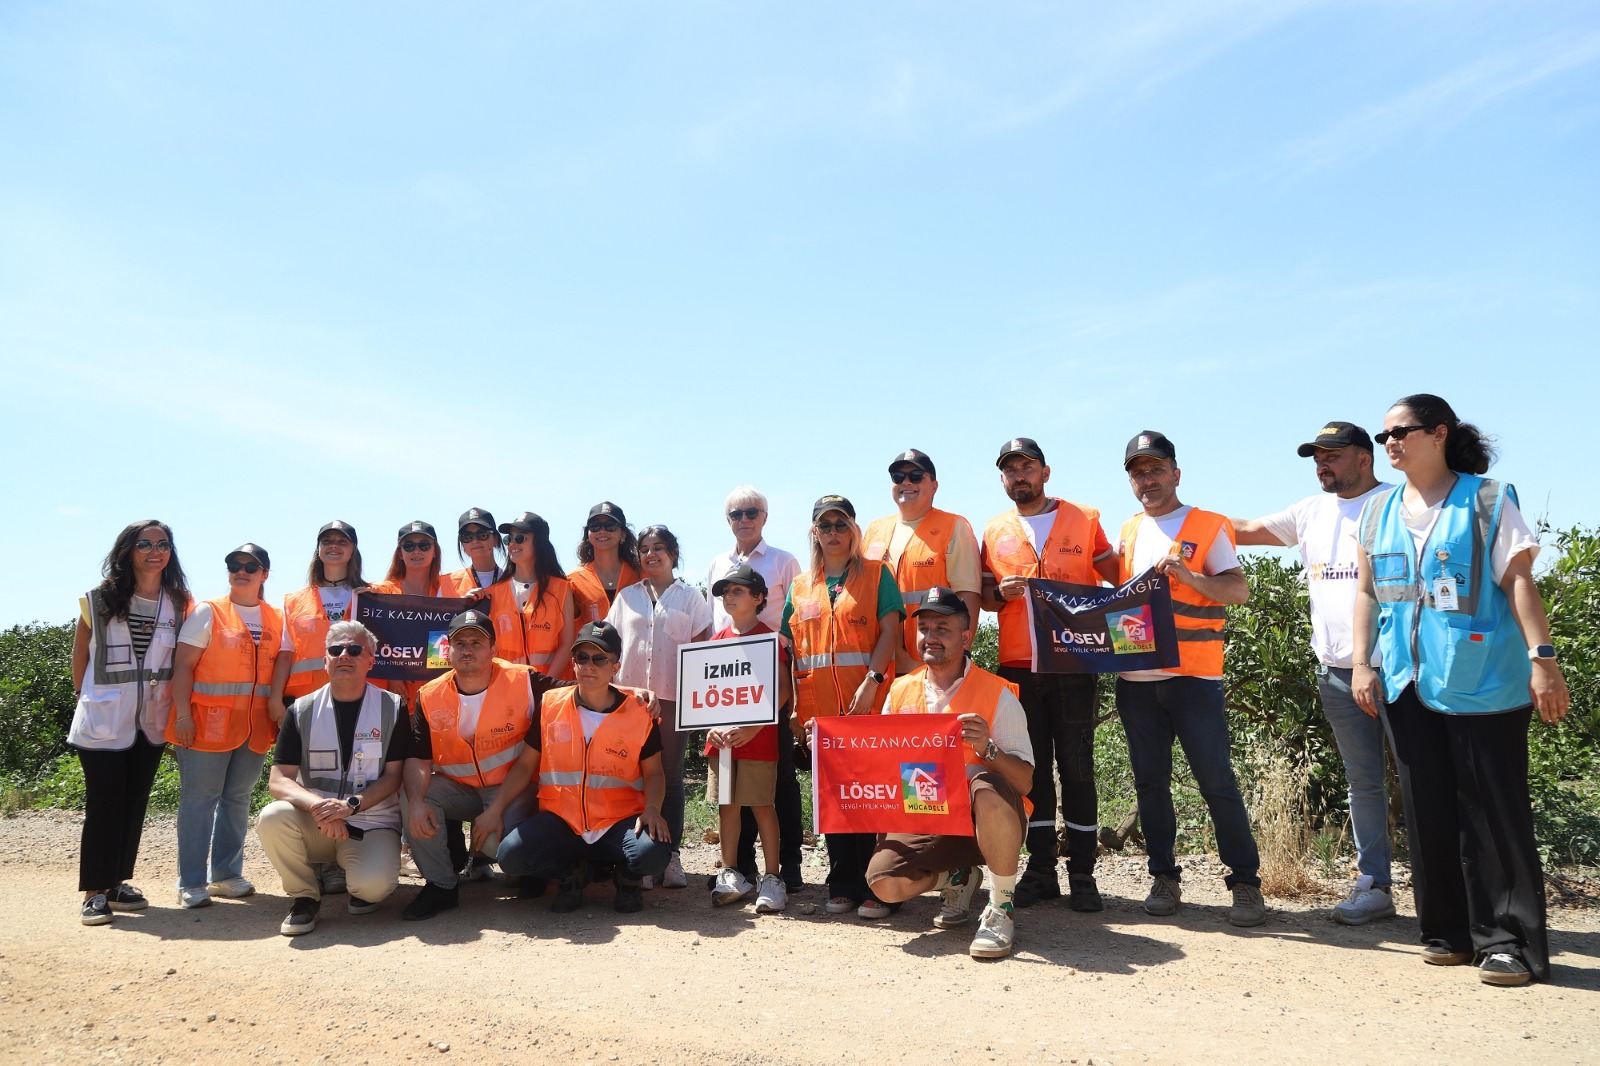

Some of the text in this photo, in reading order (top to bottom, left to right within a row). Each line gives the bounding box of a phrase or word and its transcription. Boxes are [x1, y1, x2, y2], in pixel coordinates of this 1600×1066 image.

[362, 607, 383, 618] BİZ
[388, 609, 459, 622] KAZANACA
[1052, 627, 1106, 645] LÖSEV
[1128, 624, 1143, 636] 25
[1117, 643, 1153, 652] MÜCADELE
[704, 659, 752, 680] İZMİR
[692, 684, 764, 709] LÖSEV
[822, 733, 957, 749] BİZ KAZANACAĞIZ
[840, 781, 898, 800] LÖSEV
[920, 781, 934, 796] 25
[908, 804, 945, 812] MÜCADELE
